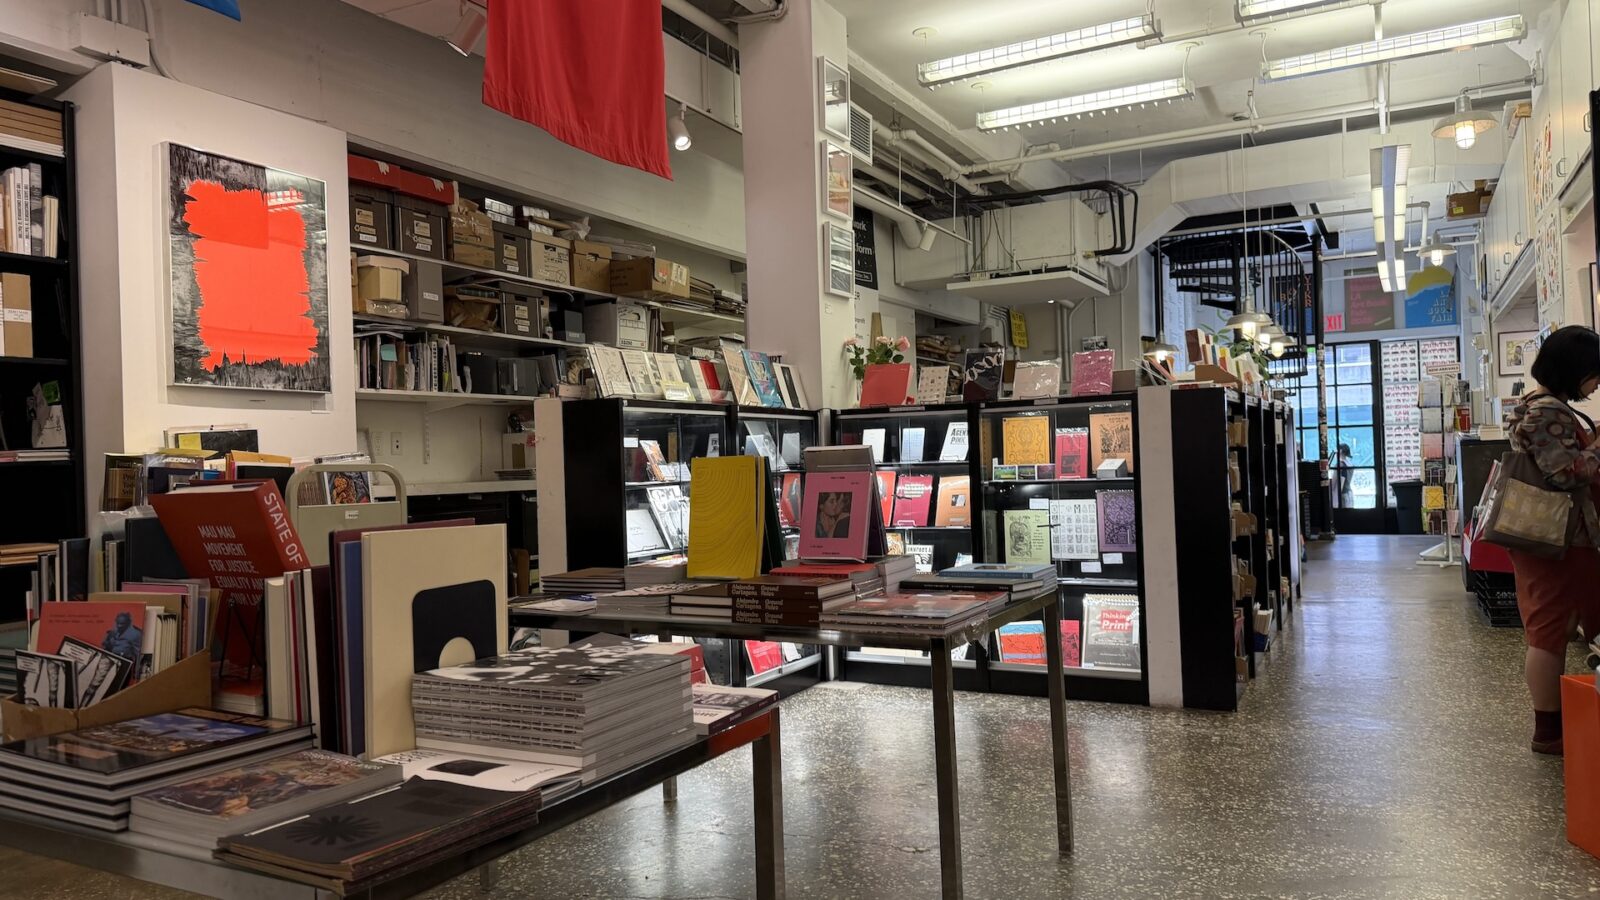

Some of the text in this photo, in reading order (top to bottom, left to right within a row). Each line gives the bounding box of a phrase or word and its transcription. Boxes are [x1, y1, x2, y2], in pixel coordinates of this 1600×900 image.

[198, 525, 236, 539] MAU MAU
[264, 492, 303, 565] STATE OF
[203, 542, 247, 557] MOVEMENT
[208, 559, 225, 572] FOR
[215, 575, 252, 589] EQUALITY
[1102, 620, 1129, 630] Print
